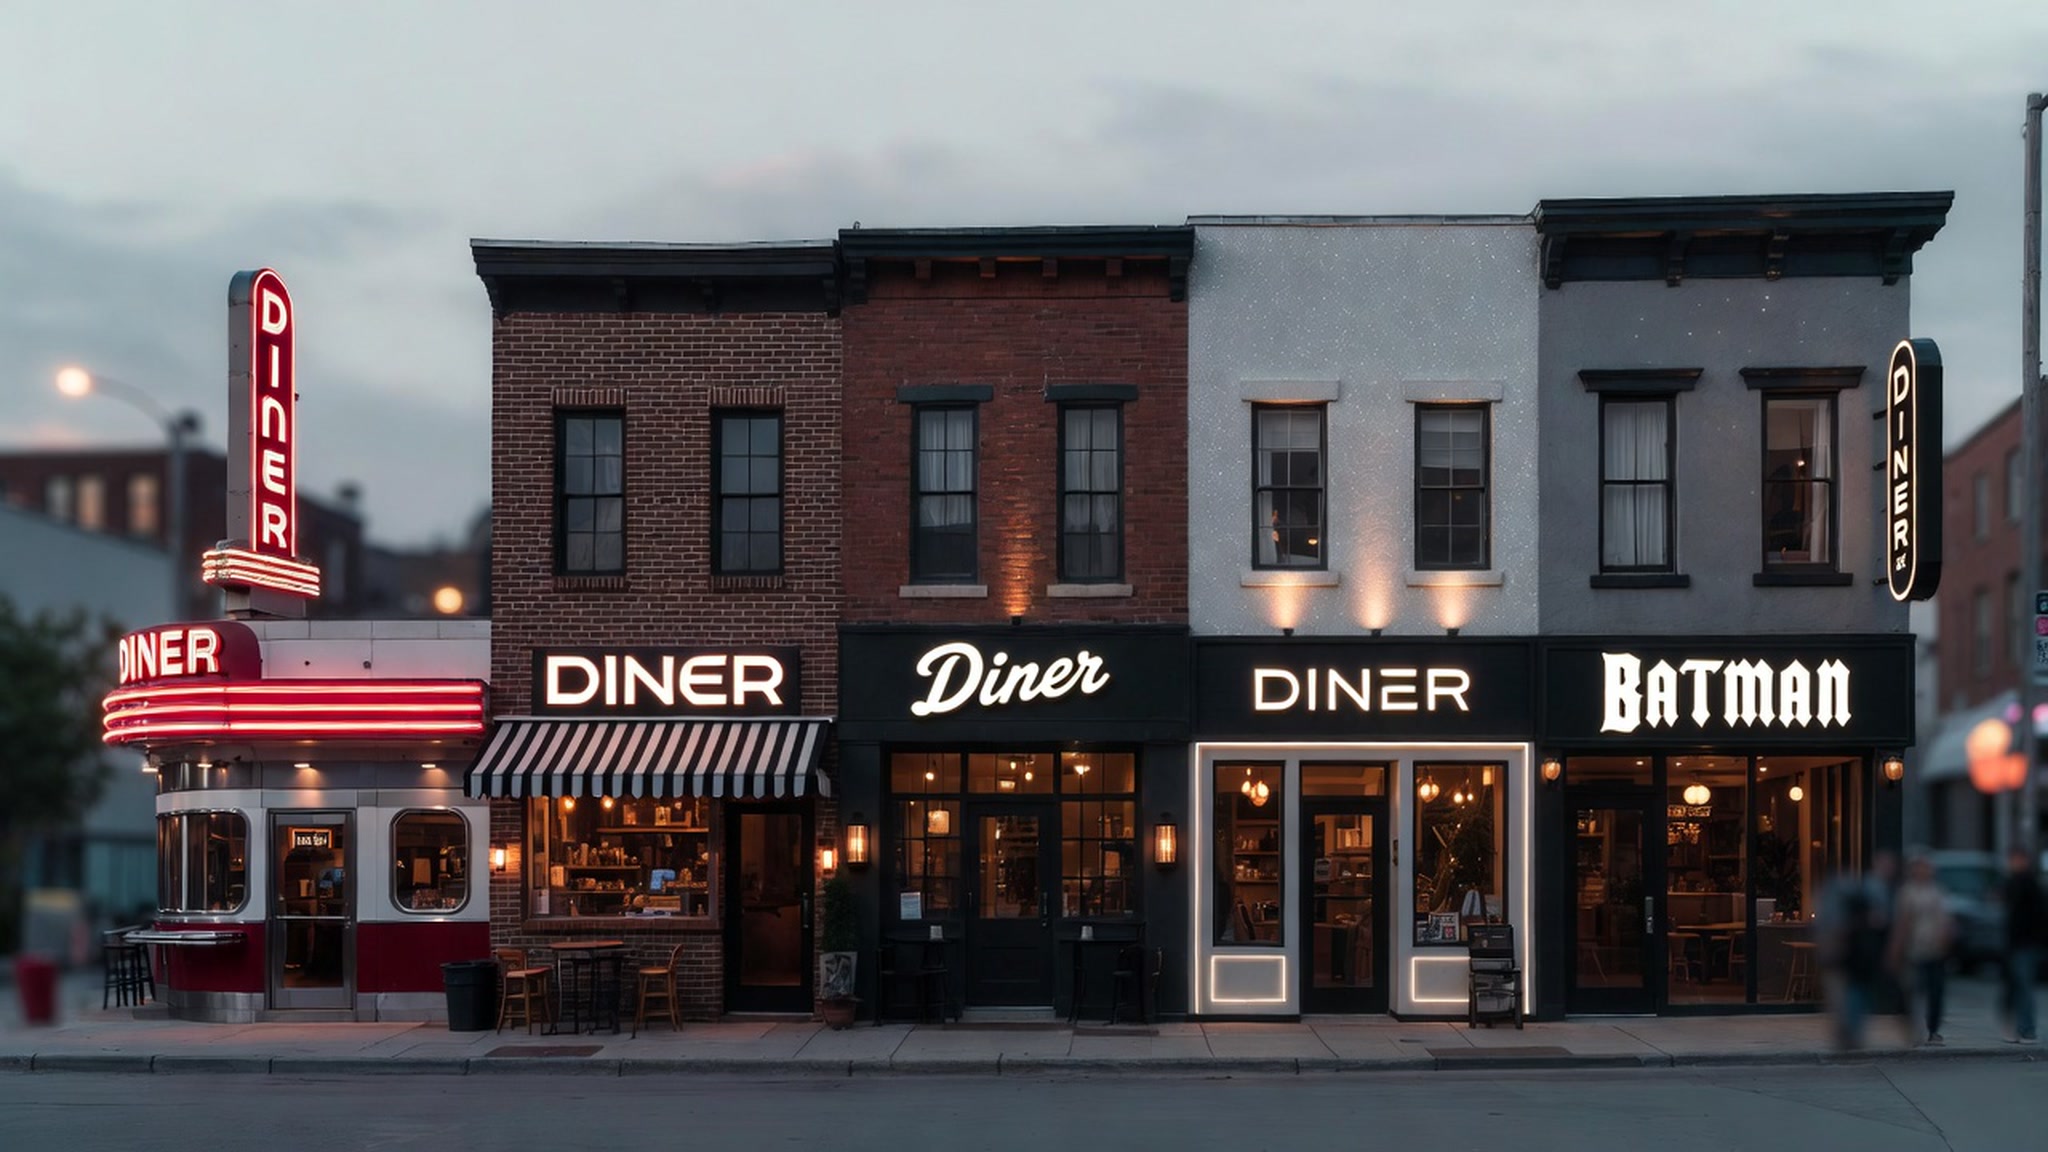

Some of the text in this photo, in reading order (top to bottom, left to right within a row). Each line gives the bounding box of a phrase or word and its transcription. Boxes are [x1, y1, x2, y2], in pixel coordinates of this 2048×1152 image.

[262, 289, 288, 548] DINER
[1893, 365, 1910, 551] DINER
[119, 628, 220, 683] DINER
[546, 655, 784, 705] DINER
[911, 642, 1110, 716] Diner
[1254, 668, 1471, 712] DINER
[1600, 652, 1852, 733] BATMAN
